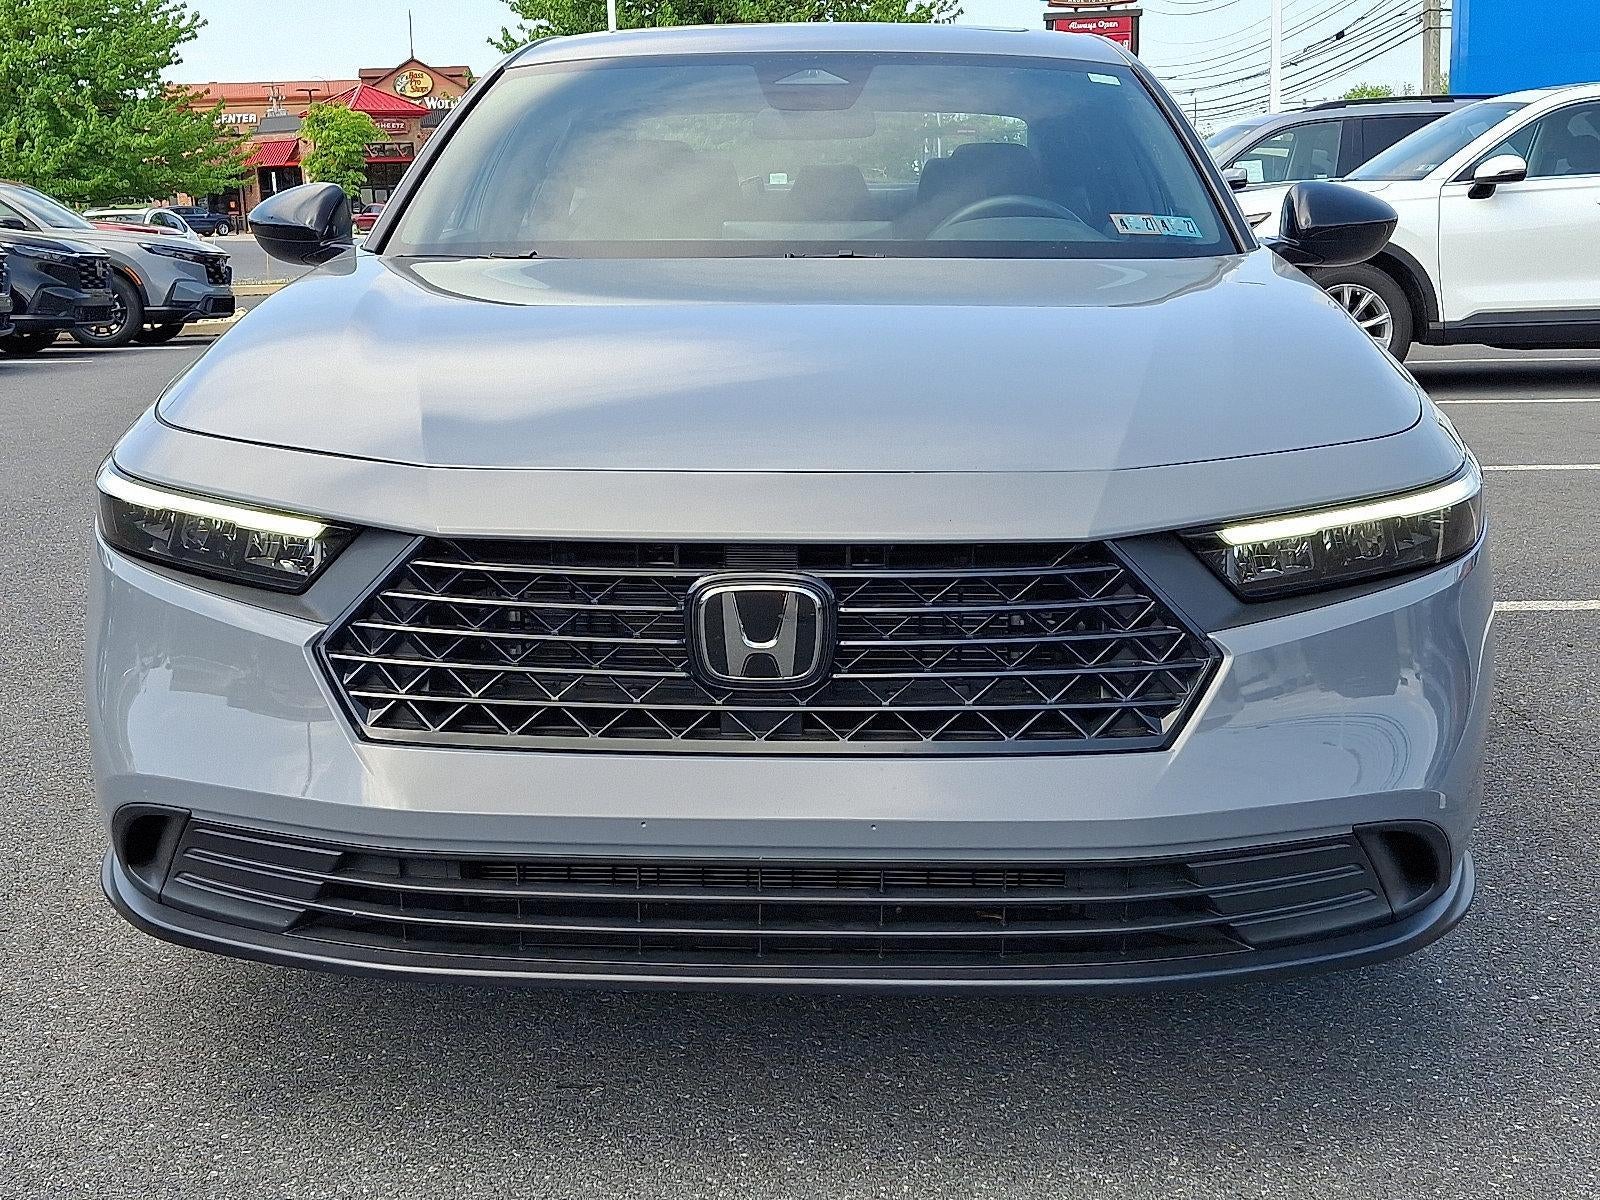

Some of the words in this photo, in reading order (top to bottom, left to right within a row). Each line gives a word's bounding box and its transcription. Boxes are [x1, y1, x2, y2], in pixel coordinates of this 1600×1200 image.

[1068, 21, 1096, 30] Always
[1098, 20, 1119, 29] Open
[408, 71, 423, 79] Bass
[410, 85, 428, 93] Shops
[376, 121, 405, 129] SHEETZ
